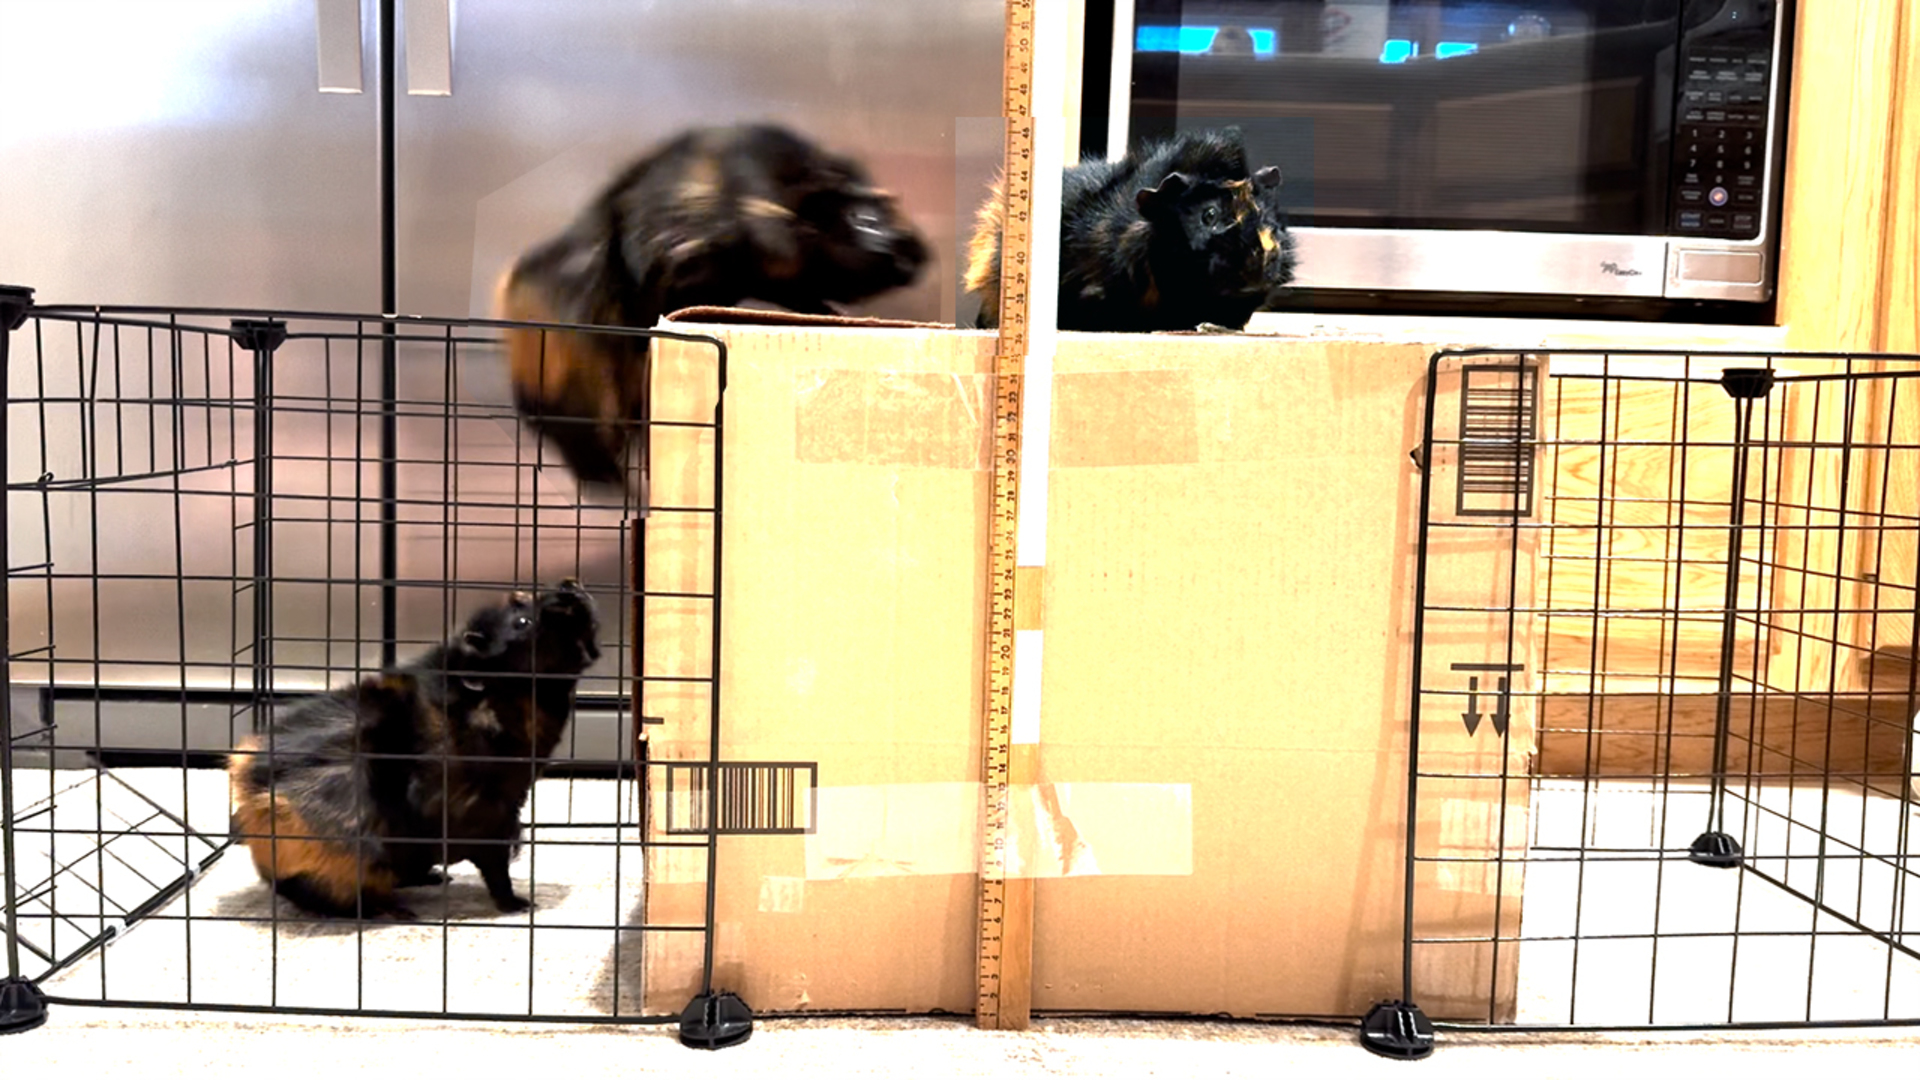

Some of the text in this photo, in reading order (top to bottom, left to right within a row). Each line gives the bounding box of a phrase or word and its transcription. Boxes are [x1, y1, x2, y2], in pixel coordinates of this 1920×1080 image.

[1020, 39, 1028, 52] 50
[1020, 84, 1028, 95] 48
[1019, 105, 1026, 115] 47
[1022, 128, 1029, 138] 46
[1692, 130, 1753, 140] 1 2 3
[1022, 148, 1029, 159] 45
[1690, 144, 1751, 155] 4 5 6
[1690, 159, 1751, 170] 7 8 9
[1020, 171, 1028, 182] 44
[1715, 175, 1722, 184] 0
[1020, 189, 1028, 201] 43
[1019, 211, 1027, 222] 42
[1016, 252, 1025, 265] 40
[1016, 272, 1025, 284] 39
[1016, 293, 1024, 304] 38
[1016, 314, 1023, 324] 37
[1015, 334, 1022, 344] 36
[1008, 433, 1016, 441] 31
[1006, 449, 1016, 464] 30
[1007, 471, 1014, 482] 29
[1007, 491, 1014, 501] 28
[1006, 510, 1013, 521] 27
[1005, 549, 1013, 559] 25
[1004, 569, 1012, 580] 24
[1004, 588, 1011, 600] 23
[1004, 608, 1011, 619] 22
[1003, 629, 1011, 638] 21
[1001, 645, 1010, 659] 20
[1001, 687, 1008, 695] 18
[1000, 706, 1008, 714] 17
[1000, 724, 1007, 734] 16
[999, 744, 1006, 753] 15
[999, 763, 1006, 773] 14
[995, 838, 1004, 849] 10
